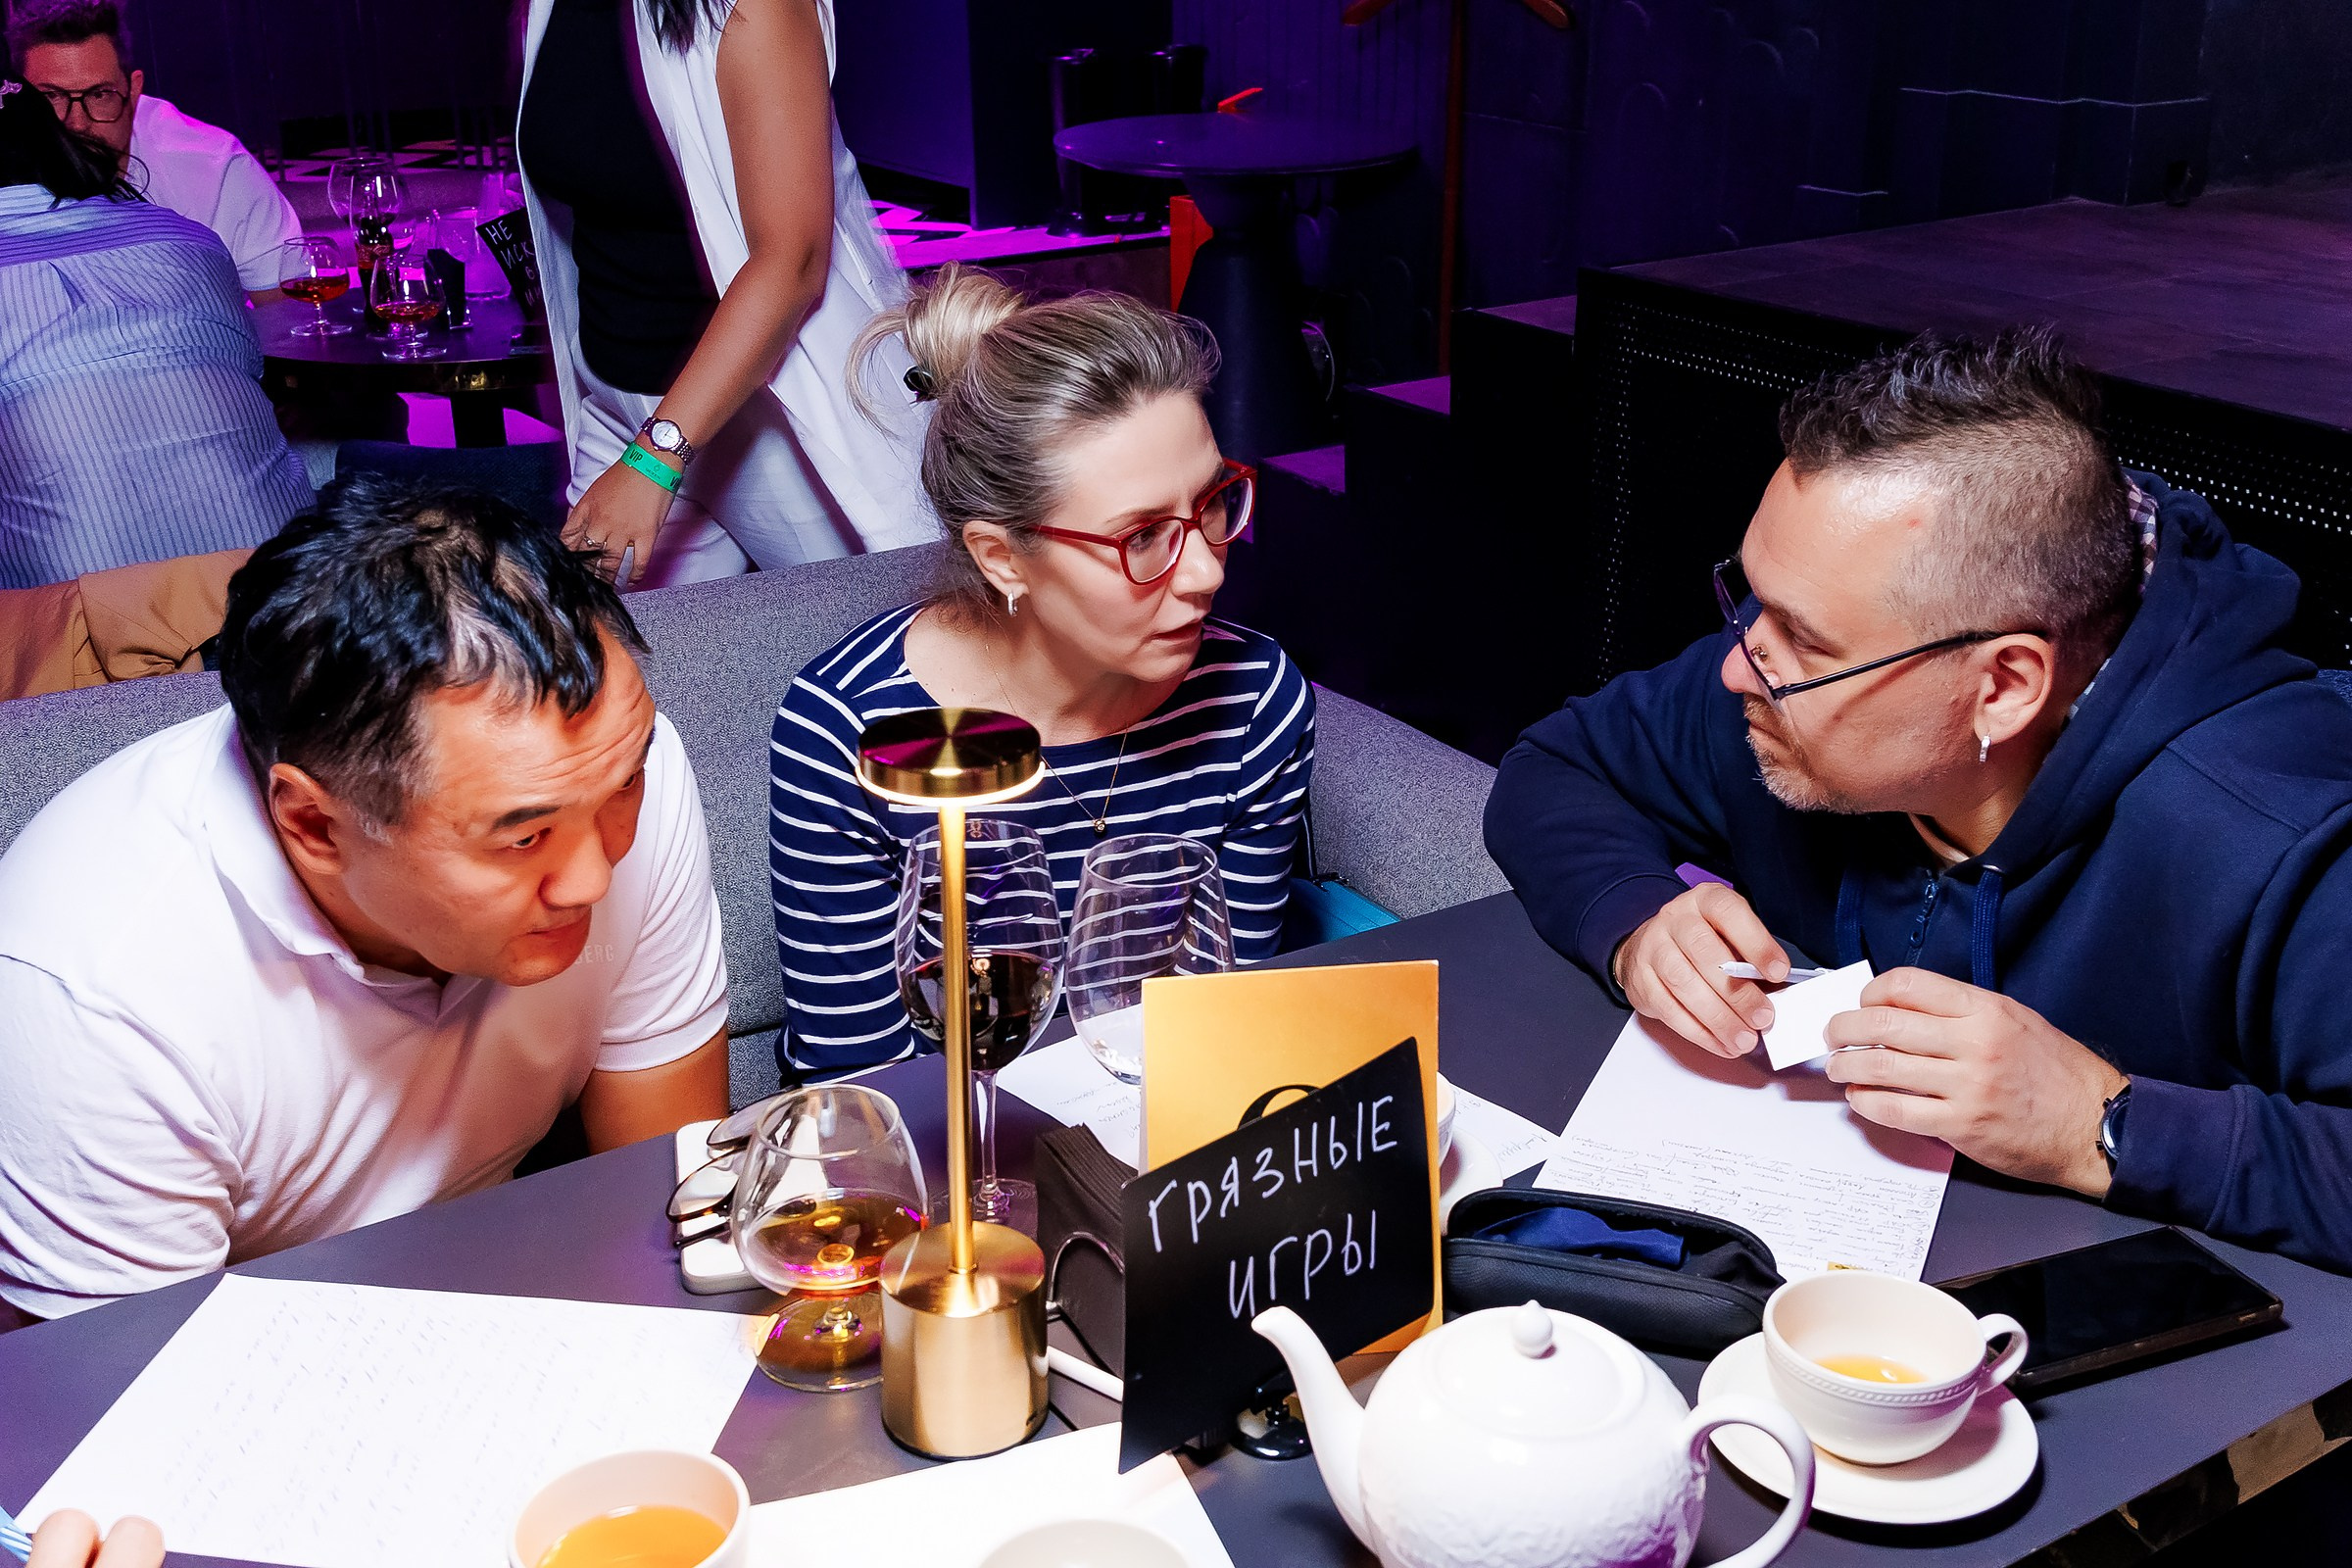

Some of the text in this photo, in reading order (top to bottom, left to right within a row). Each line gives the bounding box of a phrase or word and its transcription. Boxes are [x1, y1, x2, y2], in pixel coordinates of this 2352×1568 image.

[485, 220, 513, 245] НЕ
[500, 239, 535, 270] ИСК
[628, 448, 644, 463] VIP
[669, 476, 683, 491] VI
[1148, 1095, 1398, 1253] ГРЯЗНЫЕ
[1229, 1209, 1377, 1320] ИГРЫ
